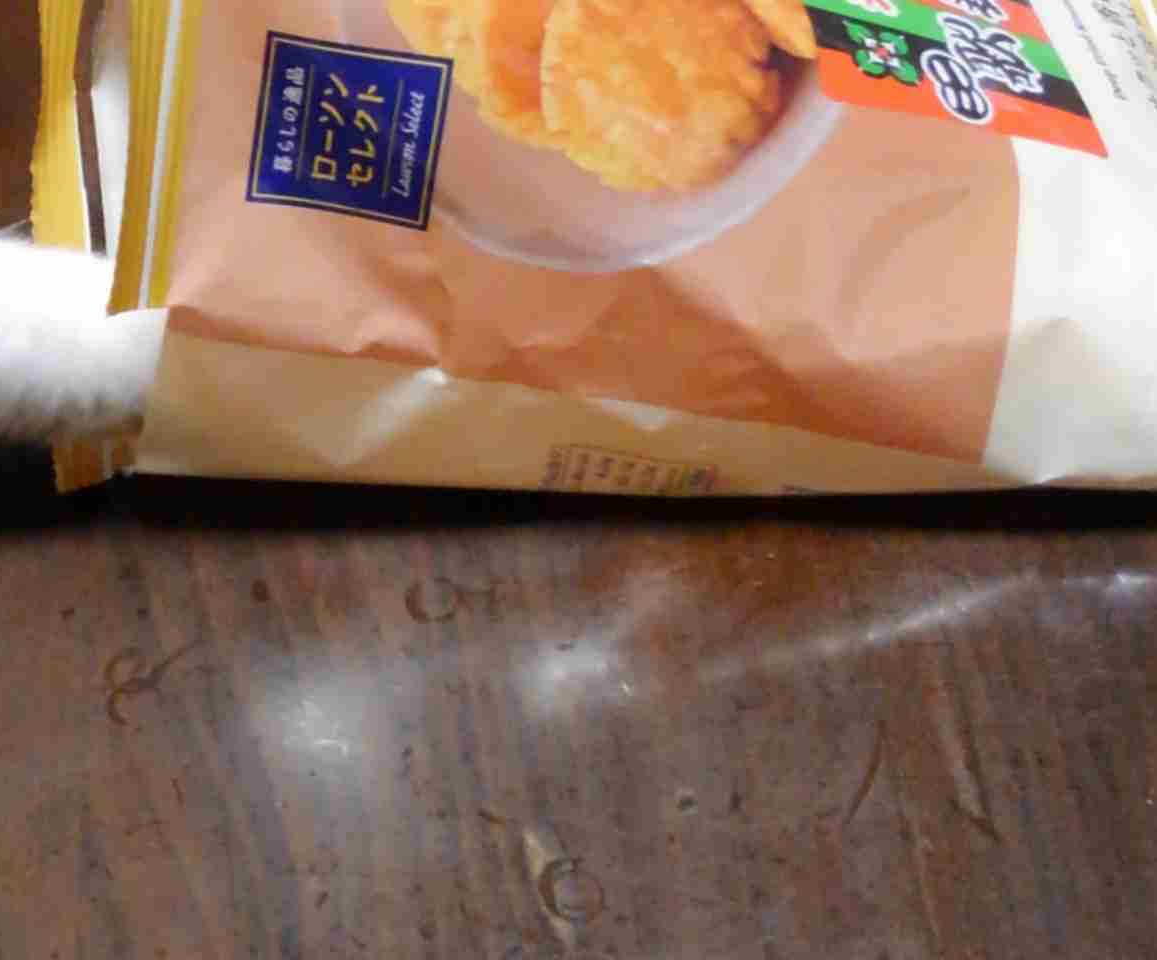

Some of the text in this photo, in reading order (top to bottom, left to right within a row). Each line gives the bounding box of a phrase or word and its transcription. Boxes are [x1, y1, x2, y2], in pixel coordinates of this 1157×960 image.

[310, 72, 350, 182] ローソン
[345, 83, 386, 188] セレクト
[391, 90, 427, 199] Lawson Select
